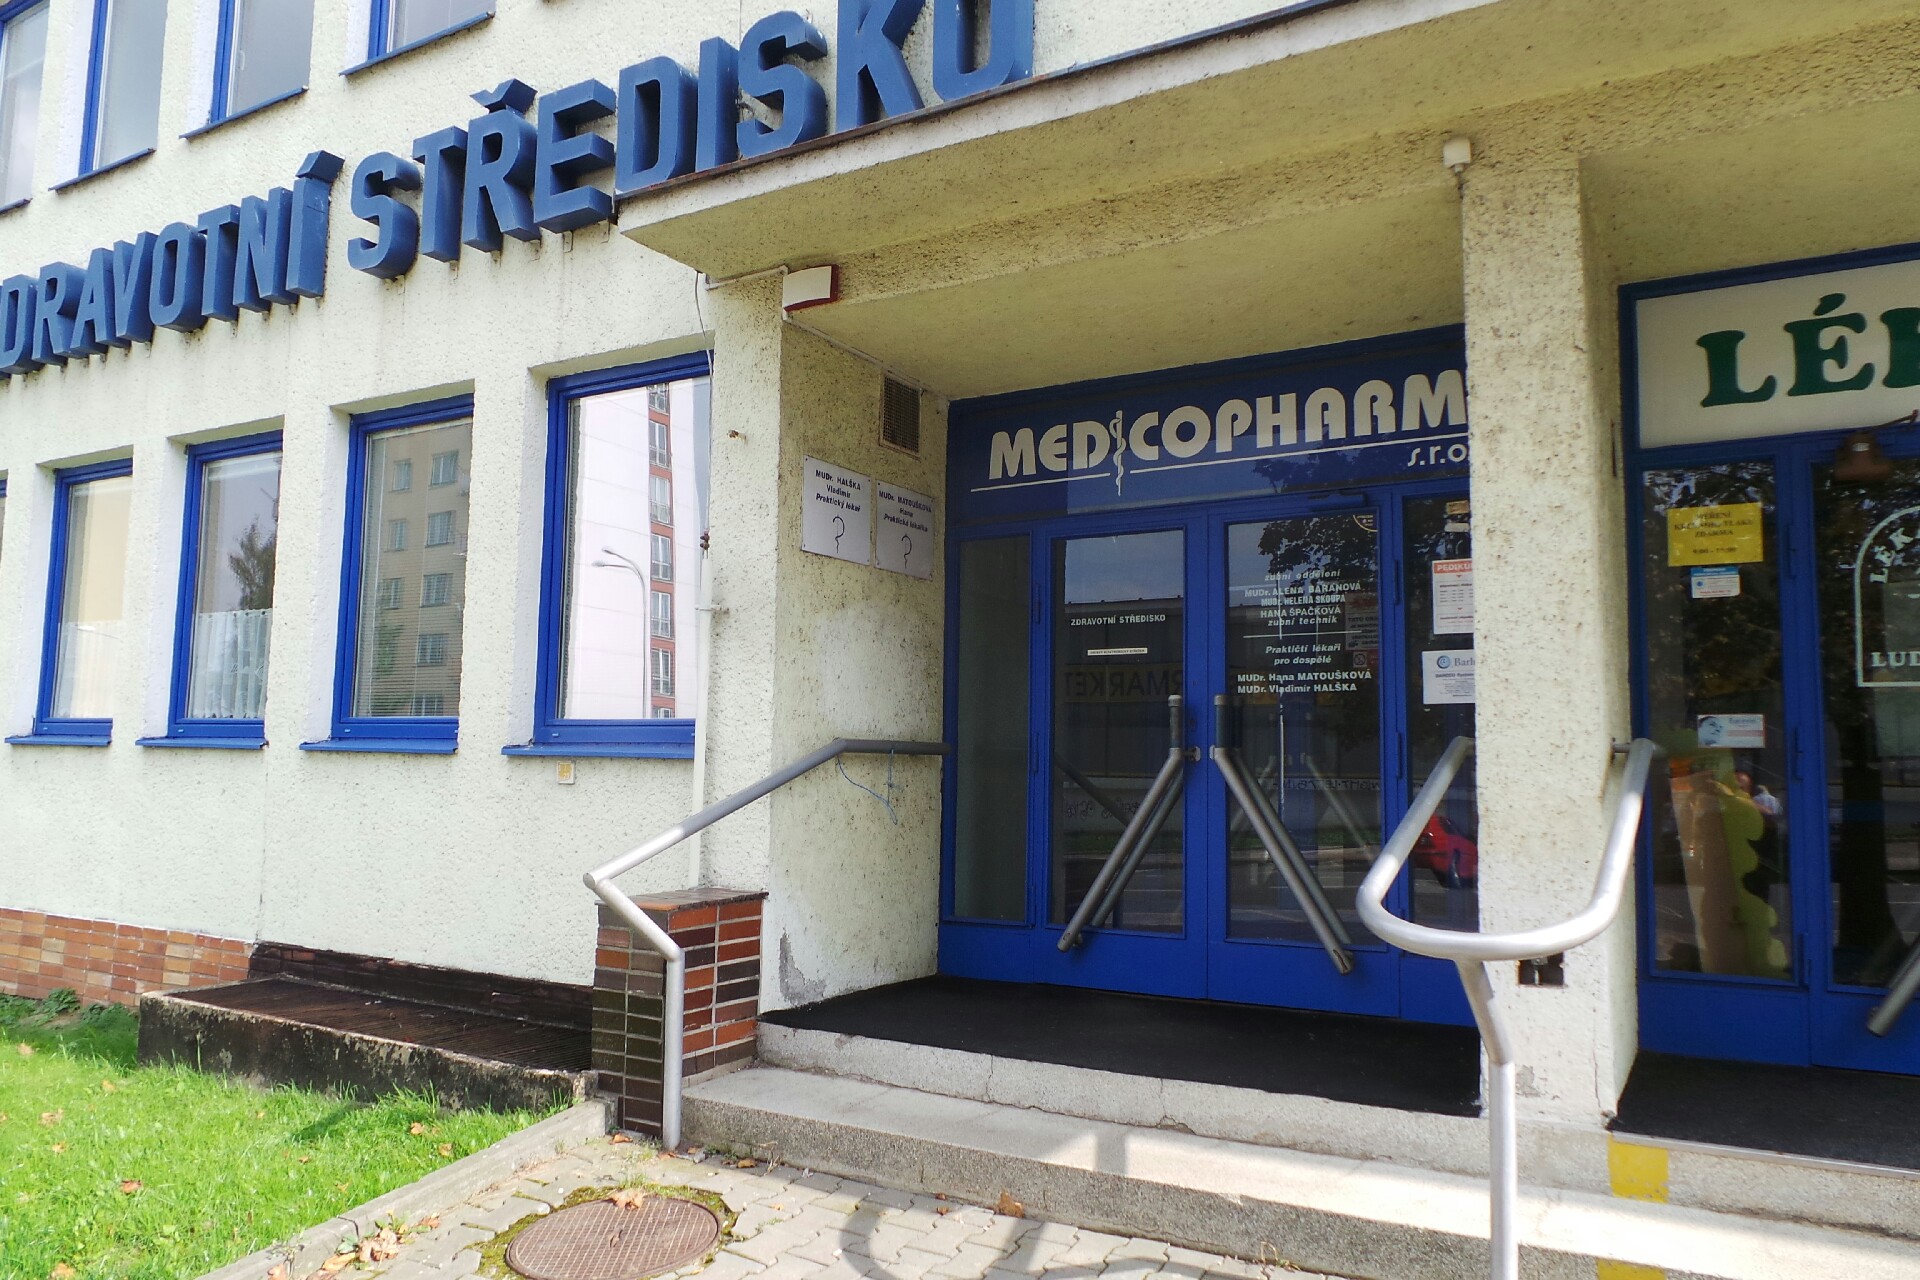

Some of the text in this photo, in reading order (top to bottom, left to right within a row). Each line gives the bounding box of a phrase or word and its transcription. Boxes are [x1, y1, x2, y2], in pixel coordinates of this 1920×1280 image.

[0, 150, 344, 379] DRAVOTNÍ
[815, 469, 861, 491] MUDr. HALŠKA
[815, 492, 845, 509] Praktický
[1437, 562, 1473, 571] PEDIKU
[1244, 589, 1271, 598] MUDr.
[1272, 587, 1304, 596] ALENA
[1284, 597, 1314, 606] HELENA
[1260, 605, 1341, 618] HANA ŠPAČKOVÁ
[1070, 613, 1166, 626] ZDRAVOTNÍ STŘEDISKO
[1267, 615, 1338, 626] zubní technik
[1265, 644, 1309, 654] Praktičtí
[1273, 655, 1332, 666] pro dospělé
[1237, 669, 1372, 682] MUDr. Hana MATOUŠKOVÁ
[1237, 681, 1357, 694] MUDr. Vladimír HALŠKA
